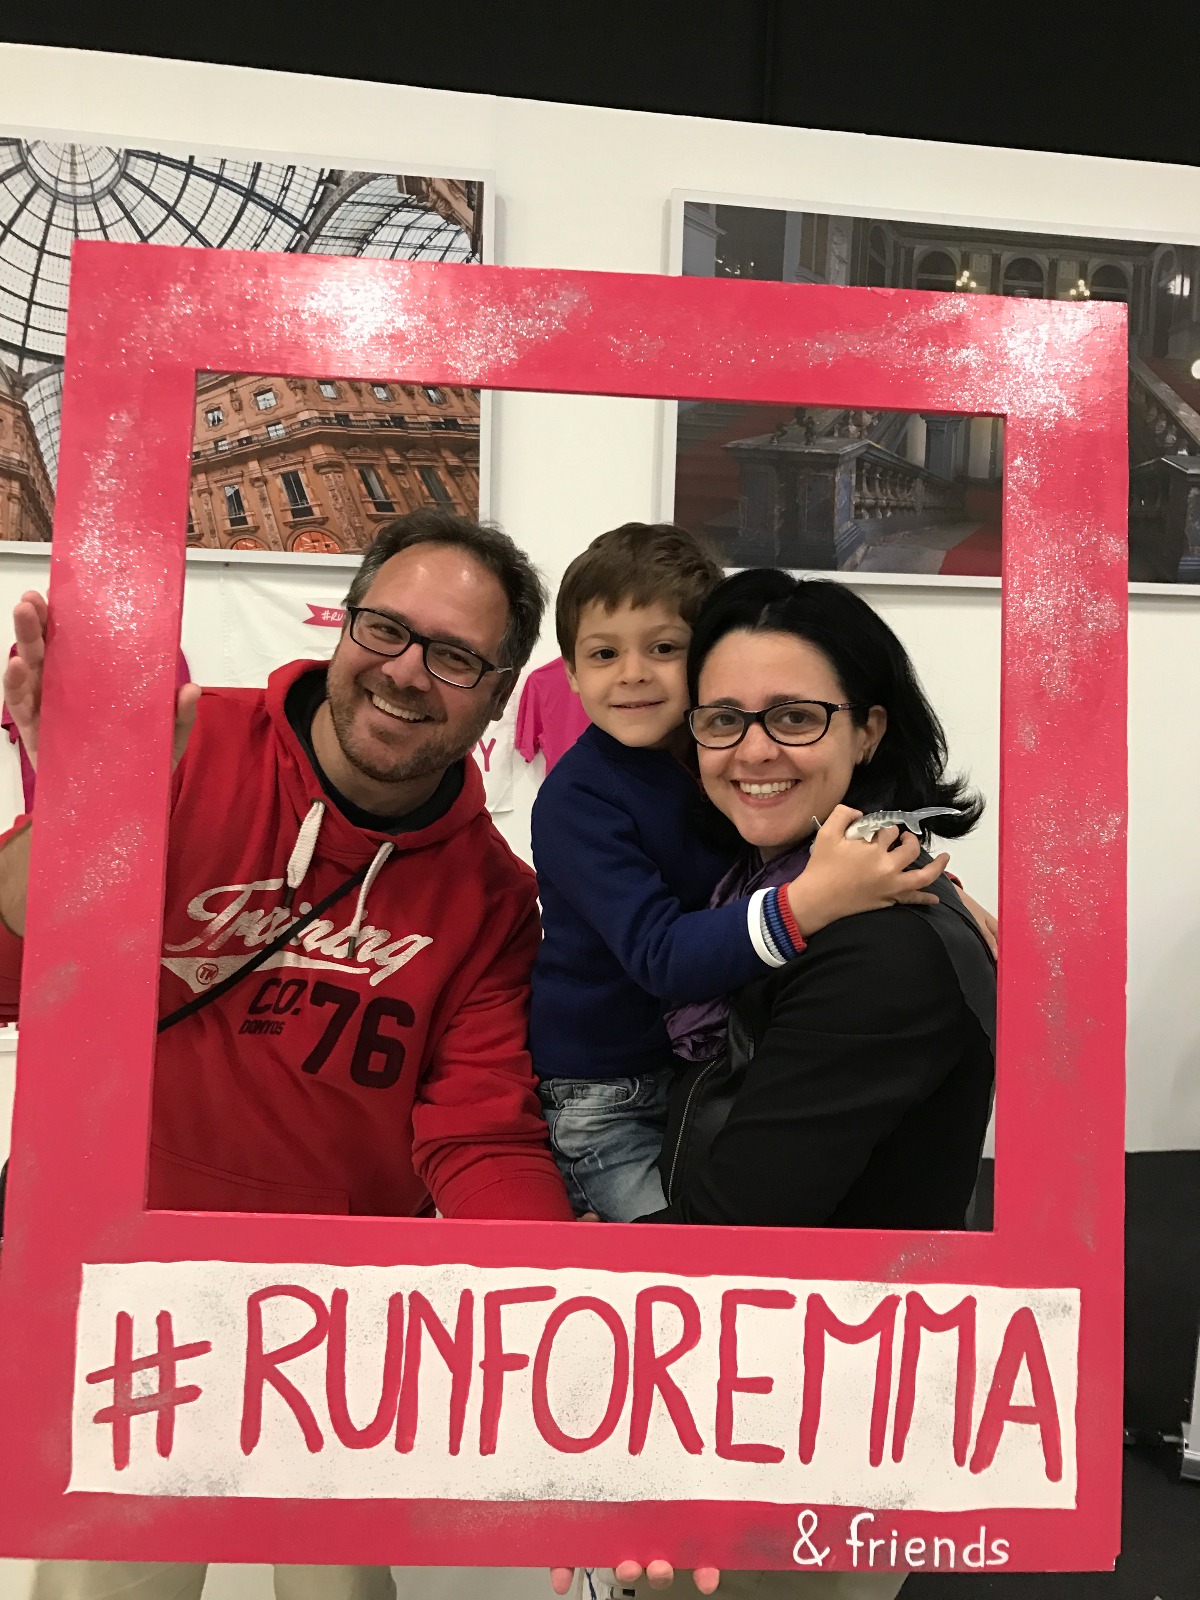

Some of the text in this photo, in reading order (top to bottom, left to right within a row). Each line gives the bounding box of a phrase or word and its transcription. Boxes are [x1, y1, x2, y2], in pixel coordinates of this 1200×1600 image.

[321, 609, 344, 622] #RU
[164, 877, 434, 987] Training
[247, 977, 415, 1090] CO. 76
[86, 1284, 1063, 1482] #RUNFOREMMA
[792, 1509, 1010, 1569] & friends
